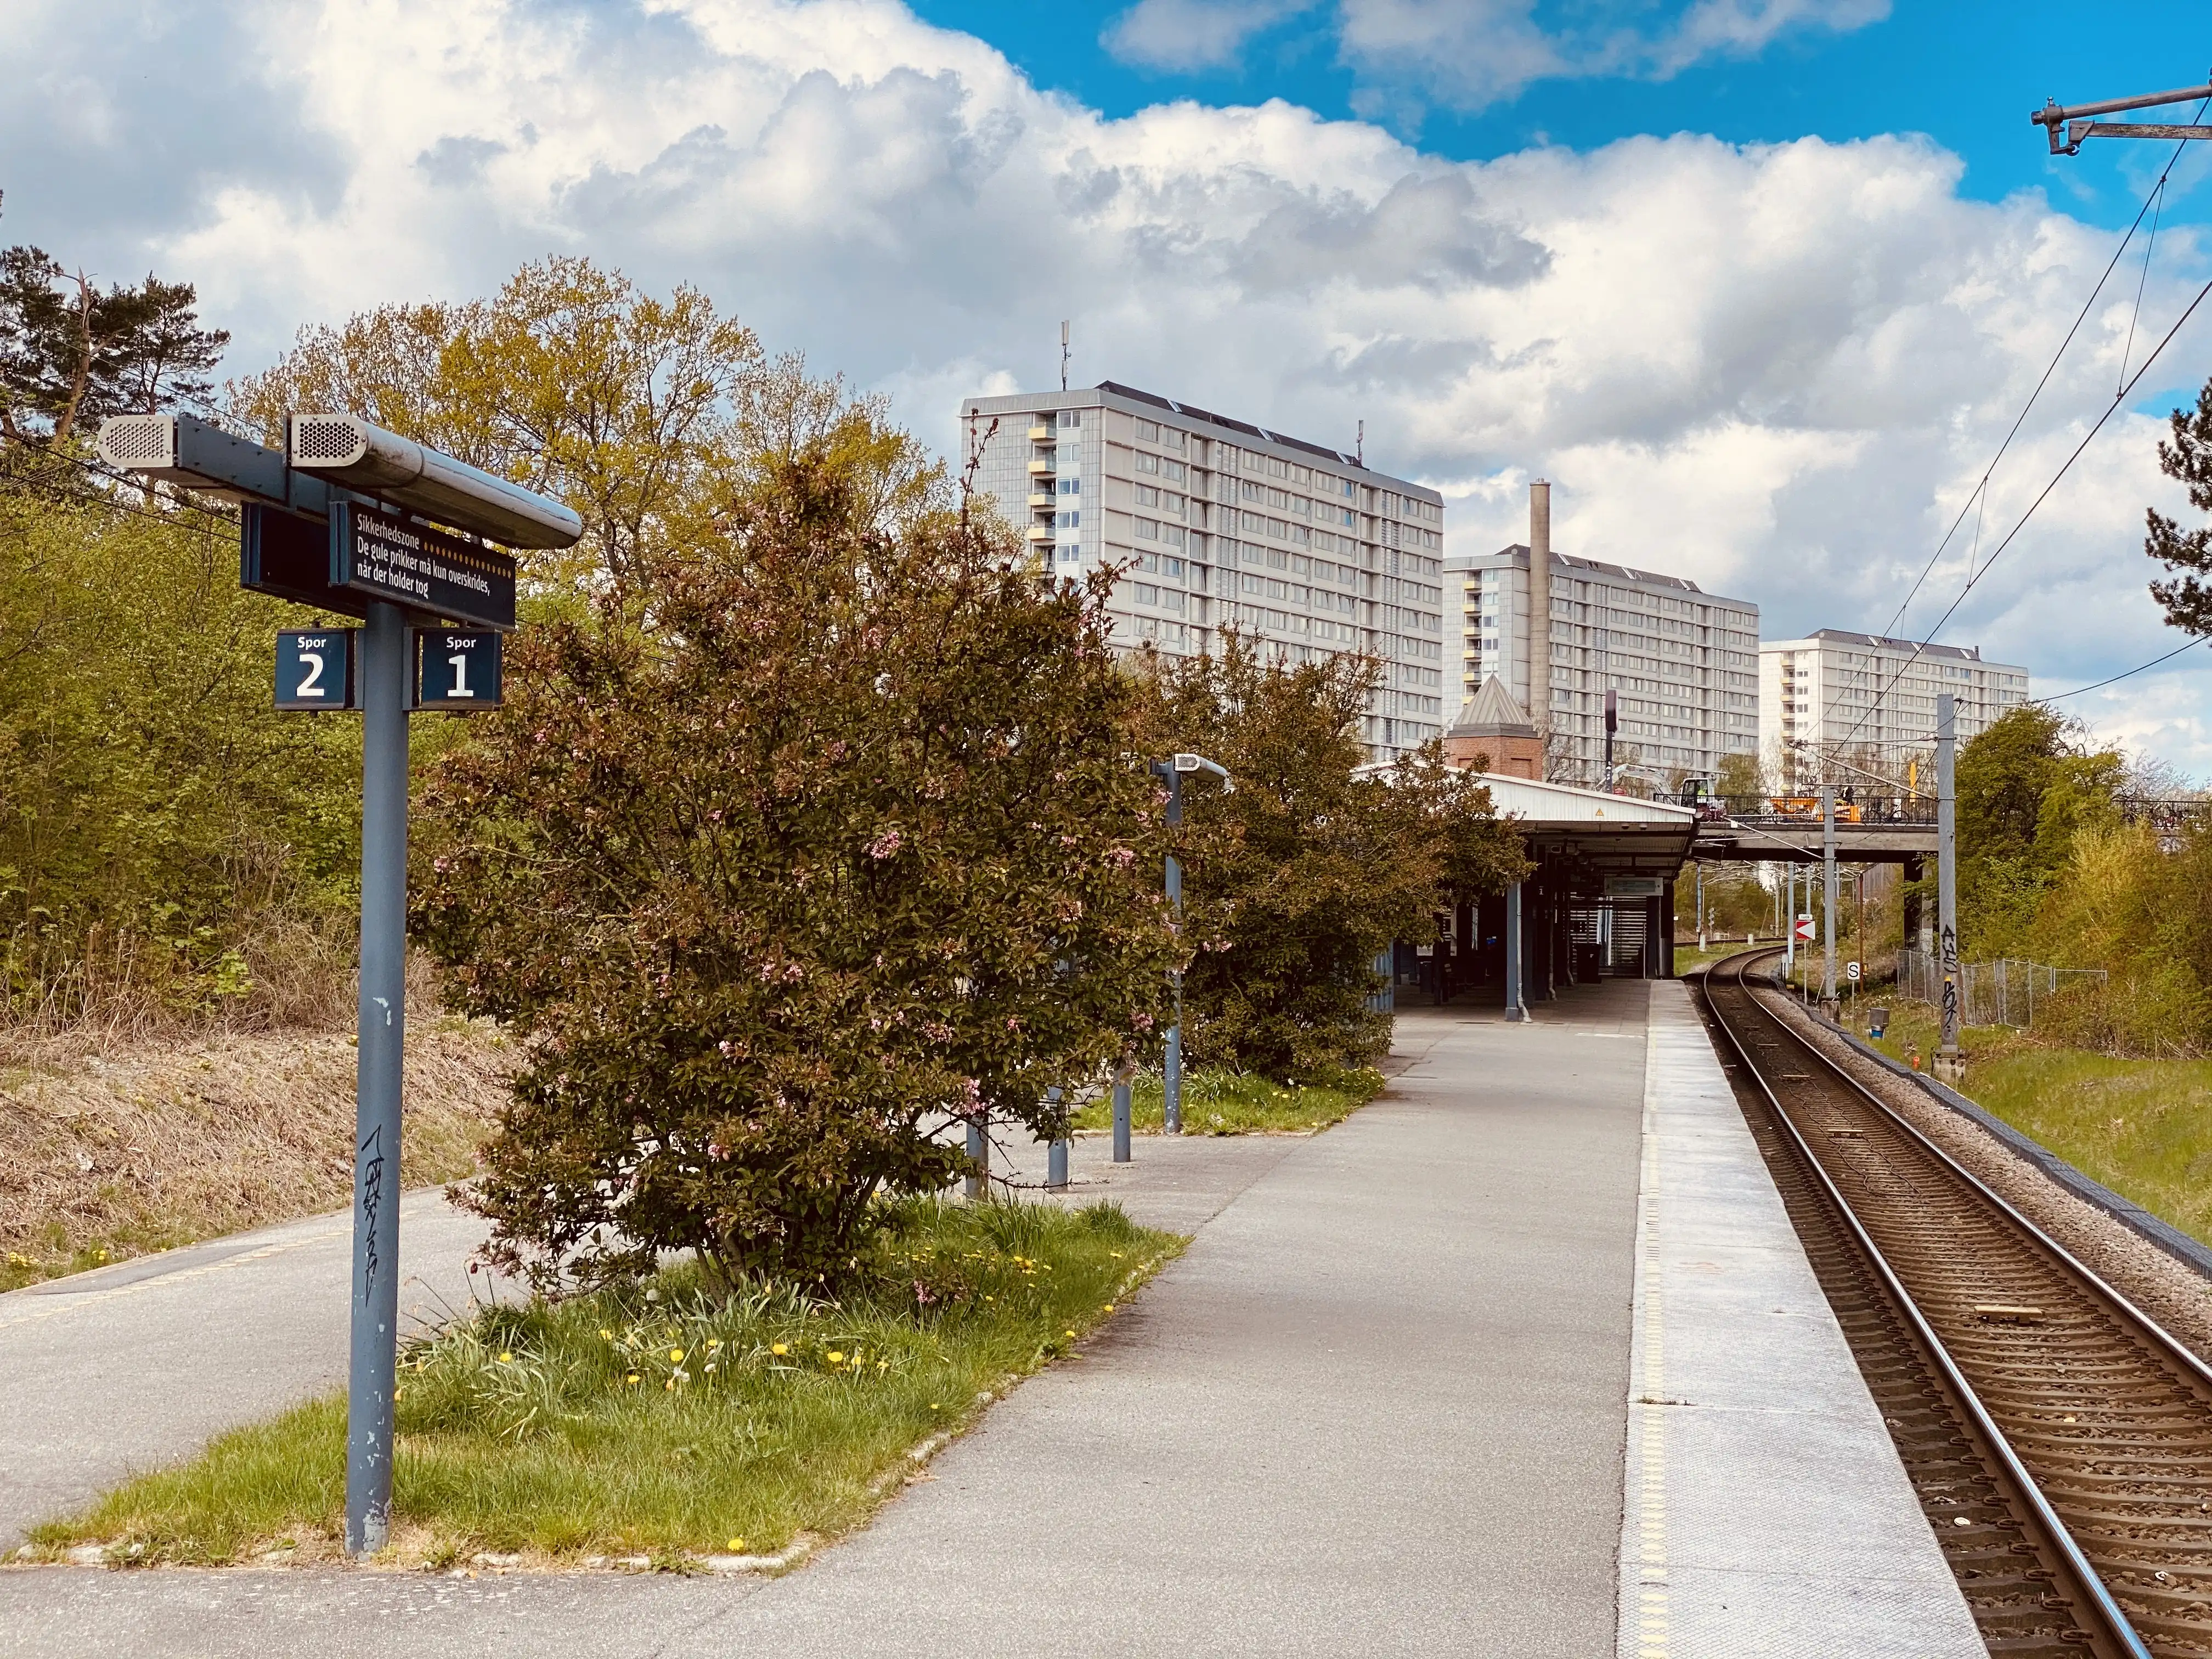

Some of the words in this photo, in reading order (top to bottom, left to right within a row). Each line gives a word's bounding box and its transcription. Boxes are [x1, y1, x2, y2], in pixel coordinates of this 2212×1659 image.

[357, 513, 419, 550] Sikkerhedszone
[357, 535, 369, 556] De
[371, 542, 388, 562] gule
[390, 549, 418, 571] prikker
[419, 557, 431, 575] må
[433, 560, 447, 580] kun
[448, 569, 490, 596] overskrides,
[357, 559, 372, 579] når
[373, 563, 387, 583] der
[388, 567, 414, 591] holder
[415, 578, 428, 599] tog
[297, 636, 326, 650] Spor
[446, 636, 477, 651] Spor
[296, 653, 324, 696] 2
[447, 654, 474, 697] 1
[1848, 964, 1859, 978] S
